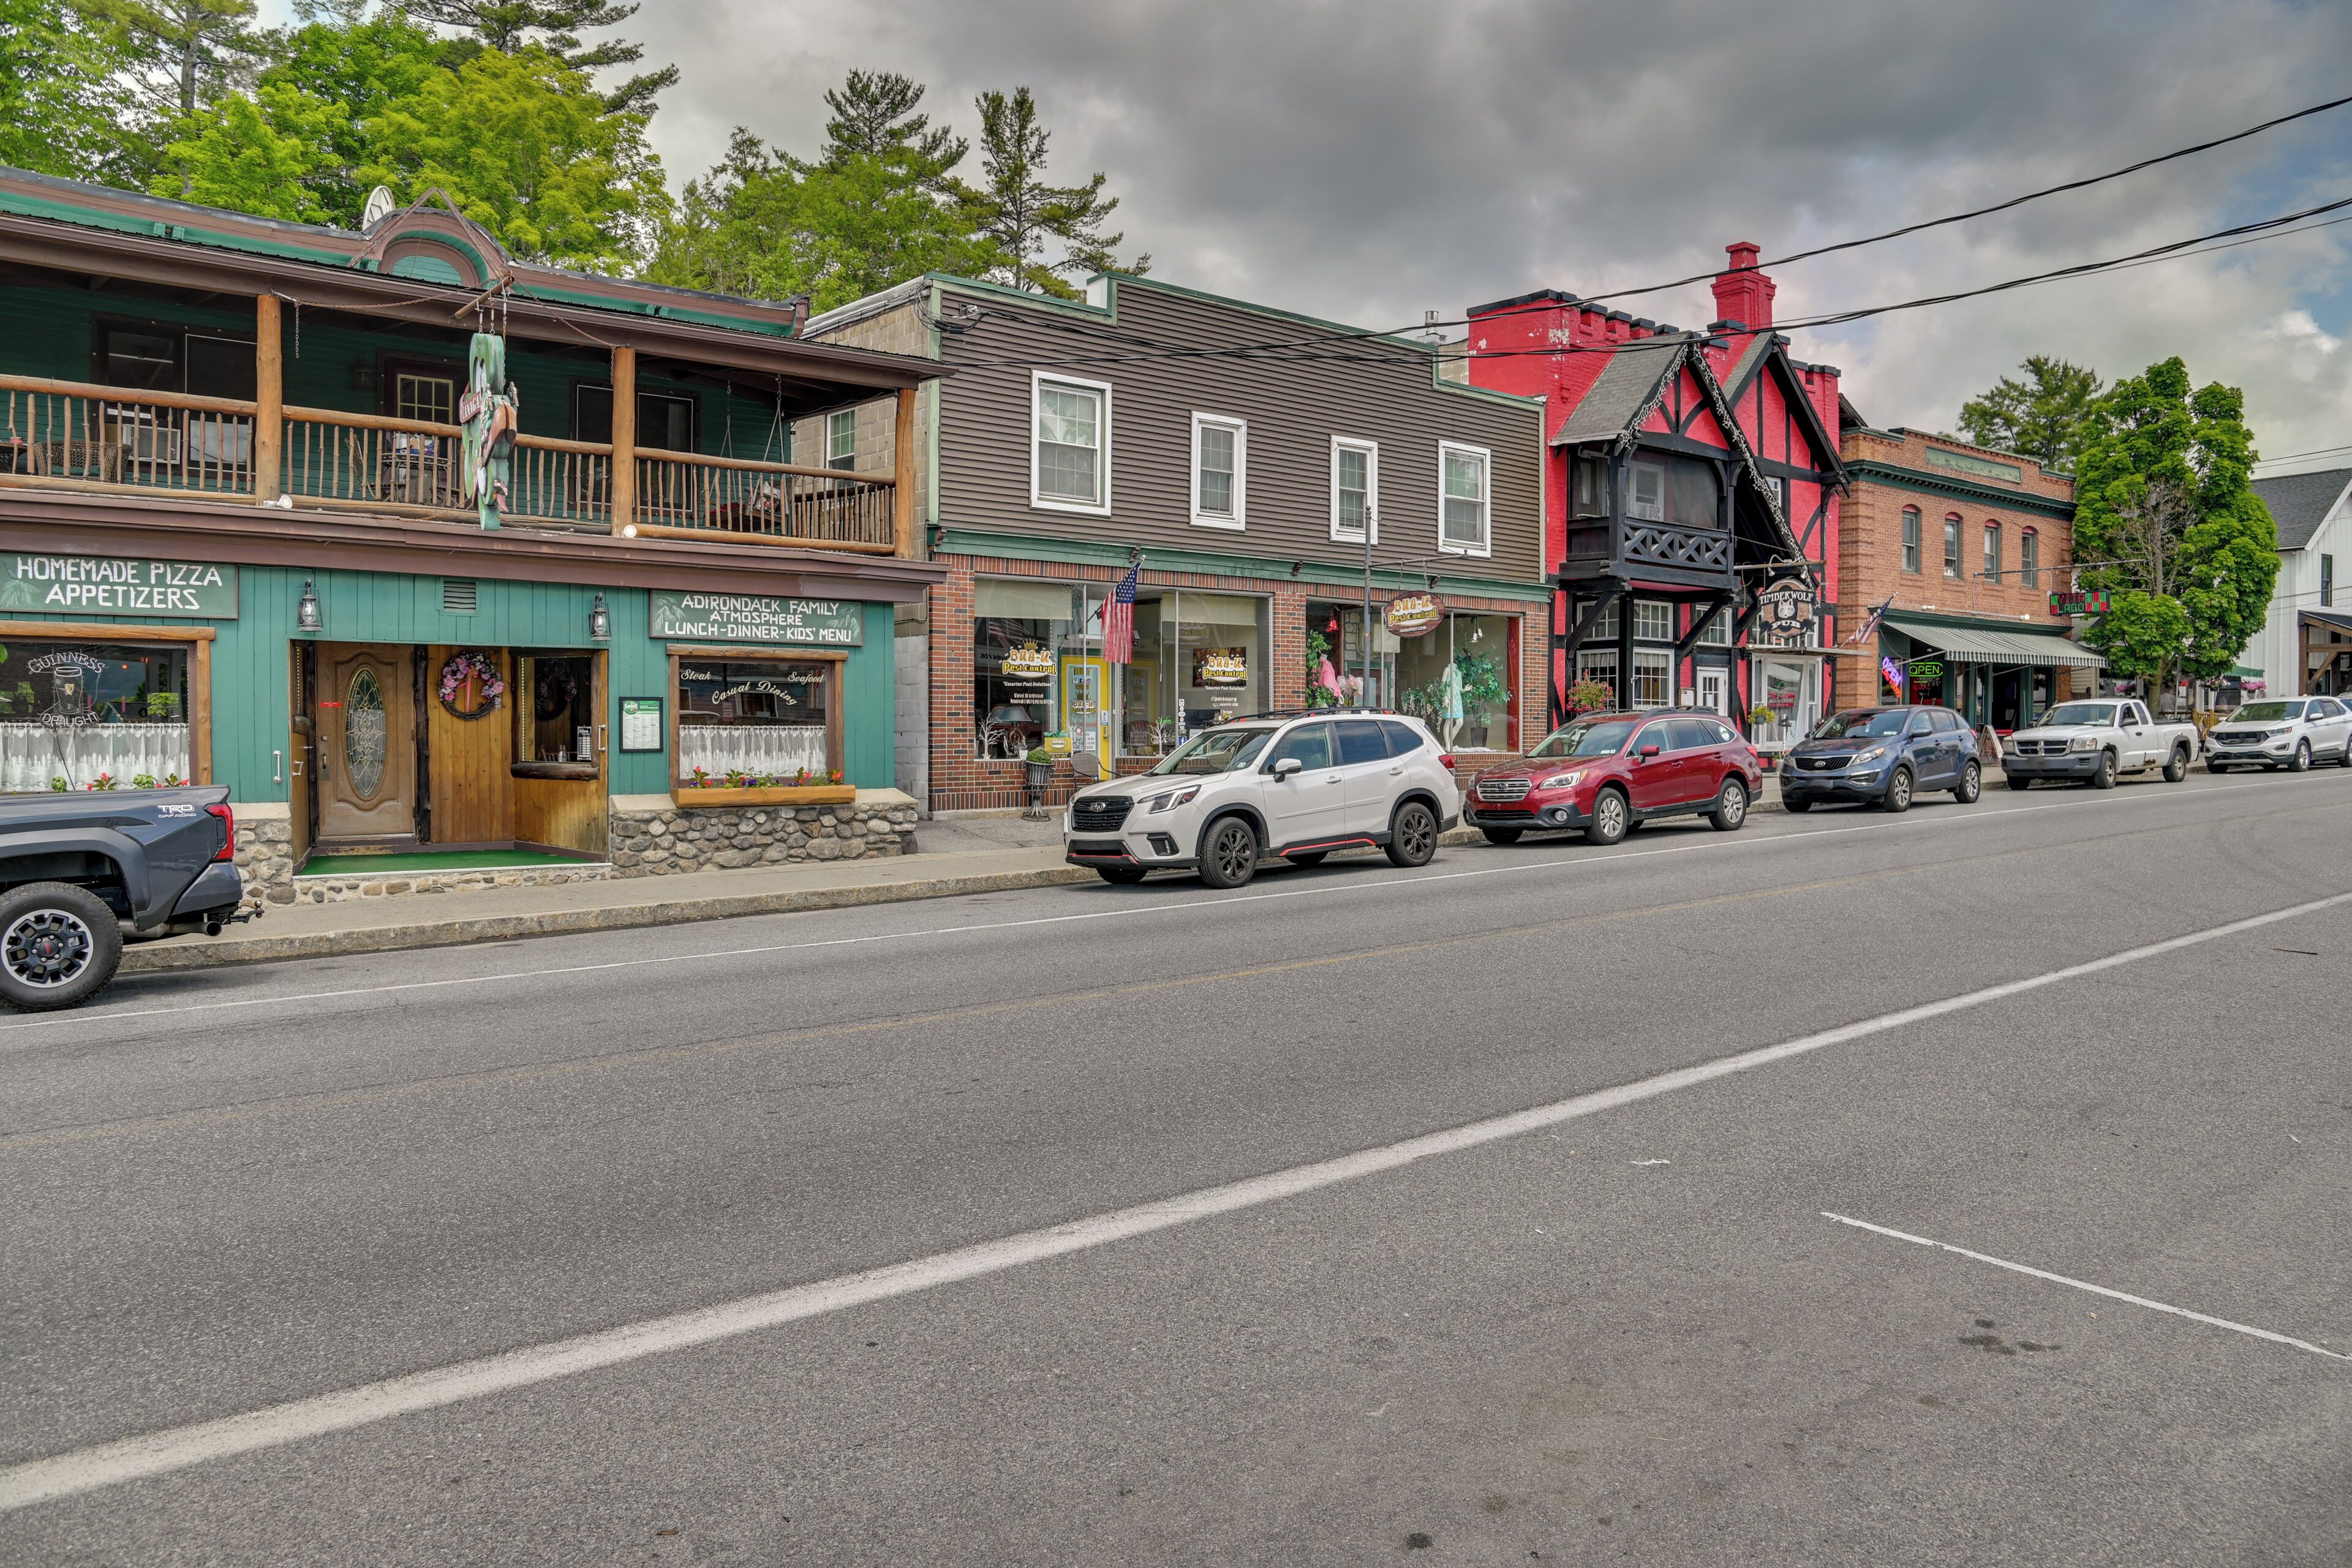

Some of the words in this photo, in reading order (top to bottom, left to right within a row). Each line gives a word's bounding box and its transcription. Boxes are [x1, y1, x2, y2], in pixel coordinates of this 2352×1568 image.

[17, 556, 140, 583] HOMEMADE
[151, 562, 222, 586] PIZZA
[45, 583, 200, 609] APPETIZERS
[1759, 591, 1814, 605] TIMBERWOLF
[2058, 594, 2085, 604] VITA
[681, 594, 780, 612] ADIRONDACK
[789, 601, 839, 616] FAMILY
[1394, 595, 1431, 612] BUG-U
[710, 610, 802, 625] ATMOSPHERE
[1389, 612, 1406, 626] Pest
[1771, 620, 1801, 630] PUB
[819, 629, 851, 642] MENU
[28, 652, 105, 673] GUINNESS
[1010, 649, 1050, 663] BUG-U
[1208, 657, 1242, 668] BUG-U
[680, 669, 712, 680] Steak
[1003, 661, 1023, 673] Pest
[1024, 662, 1057, 674] Control
[1203, 668, 1219, 679] Pest
[1219, 669, 1248, 679] Control
[1882, 657, 1902, 687] OPEN
[1909, 665, 1940, 675] OPEN
[788, 671, 824, 685] Seafood
[712, 681, 750, 704] Casual
[756, 680, 797, 705] Dining
[42, 711, 99, 728] DRAUGHT
[157, 804, 195, 814] TRD
